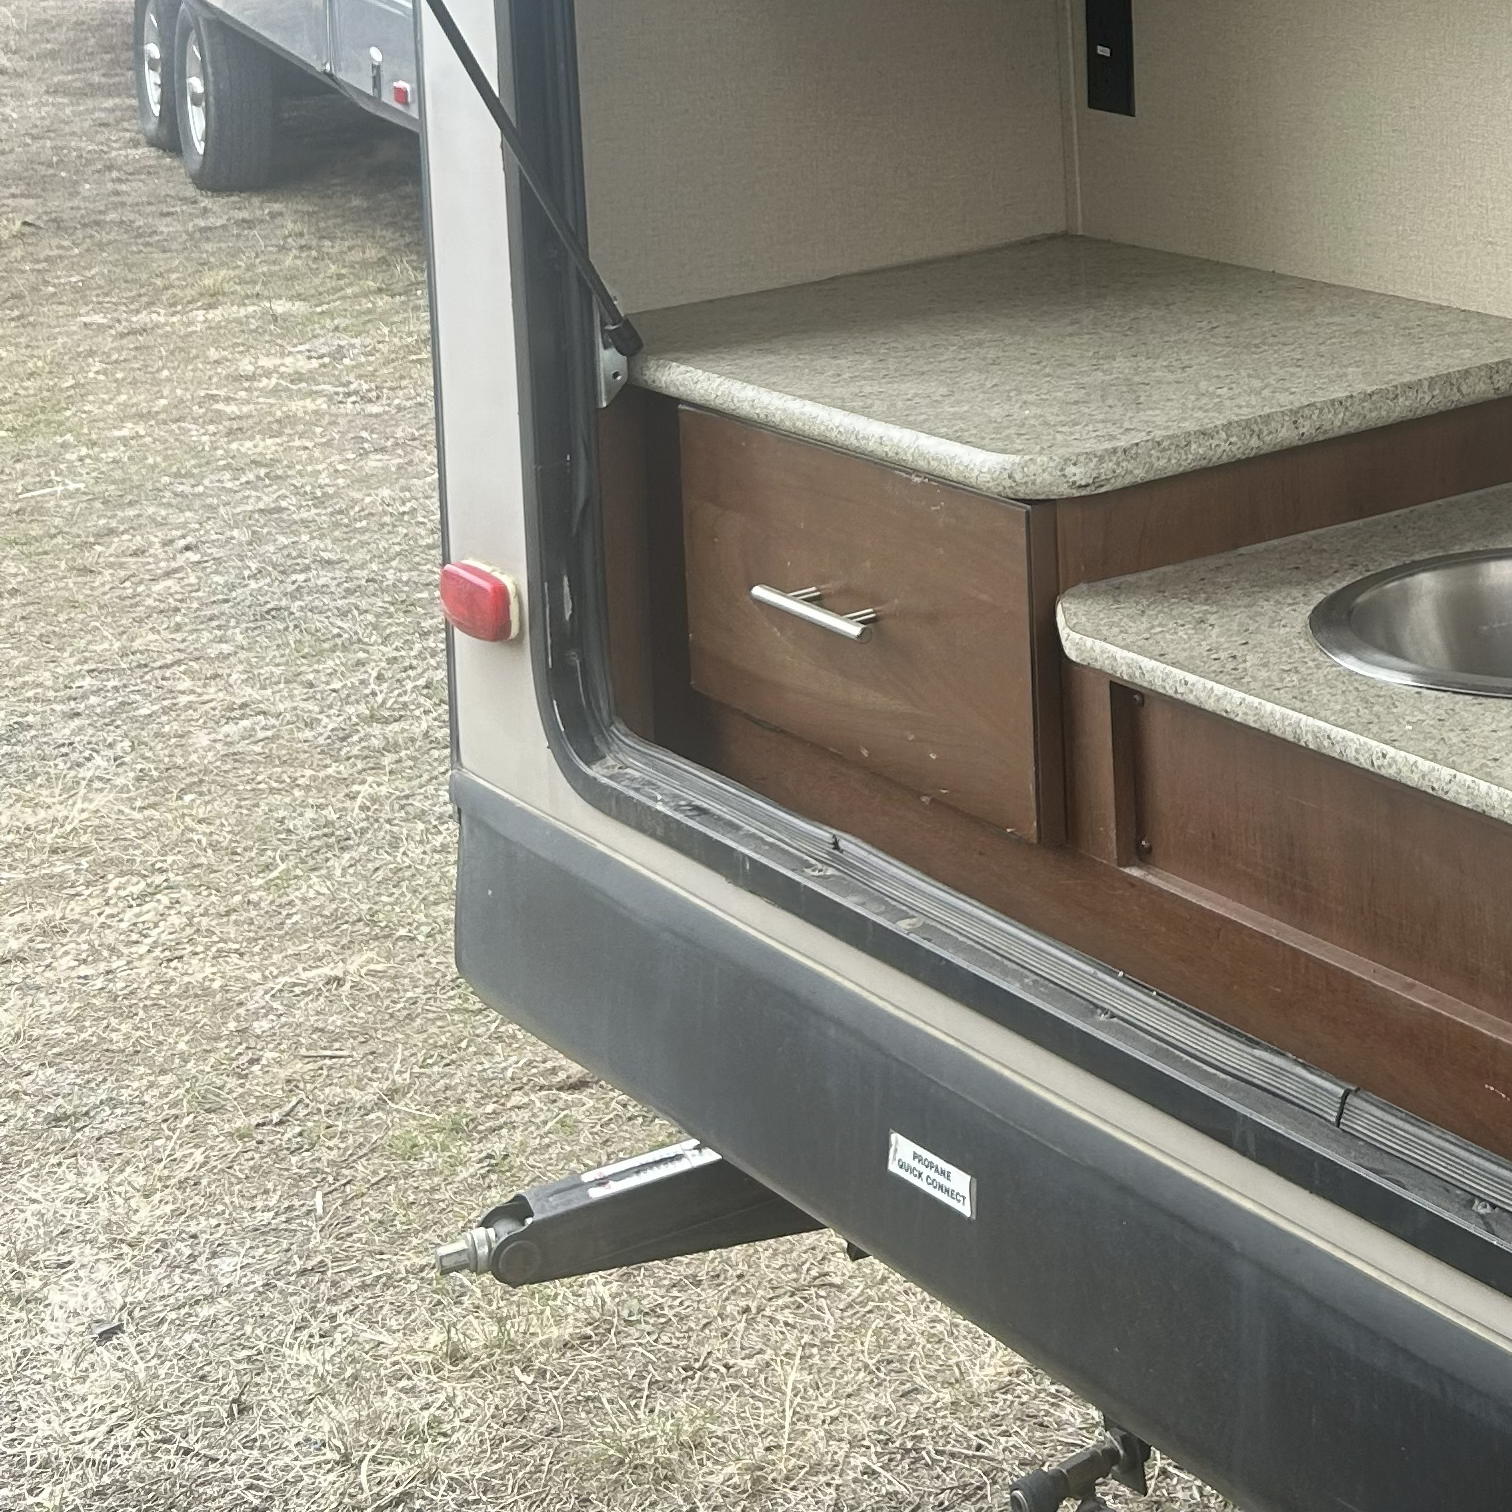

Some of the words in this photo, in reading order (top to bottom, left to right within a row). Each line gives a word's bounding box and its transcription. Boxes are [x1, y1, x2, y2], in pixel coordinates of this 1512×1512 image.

[898, 1158, 923, 1181] QUICK
[926, 1175, 966, 1206] CONNECT
[913, 1151, 951, 1182] PROPANE
